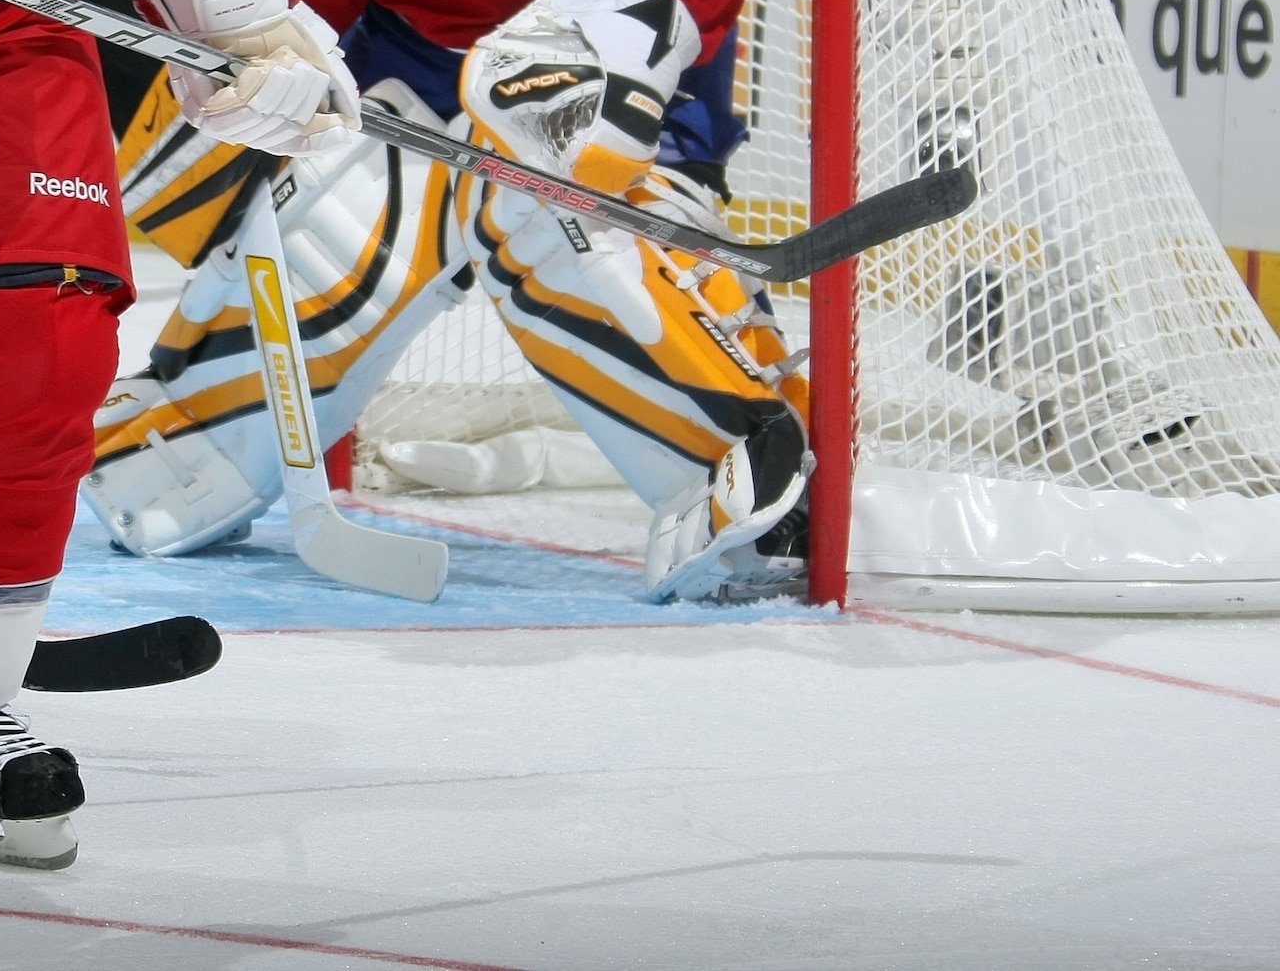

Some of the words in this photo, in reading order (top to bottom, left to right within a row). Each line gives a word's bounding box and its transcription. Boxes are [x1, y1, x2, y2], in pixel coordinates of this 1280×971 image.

[496, 70, 580, 97] VAPOR
[29, 172, 111, 208] Reebok
[472, 155, 599, 212] RESPONSE
[563, 216, 588, 251] UER
